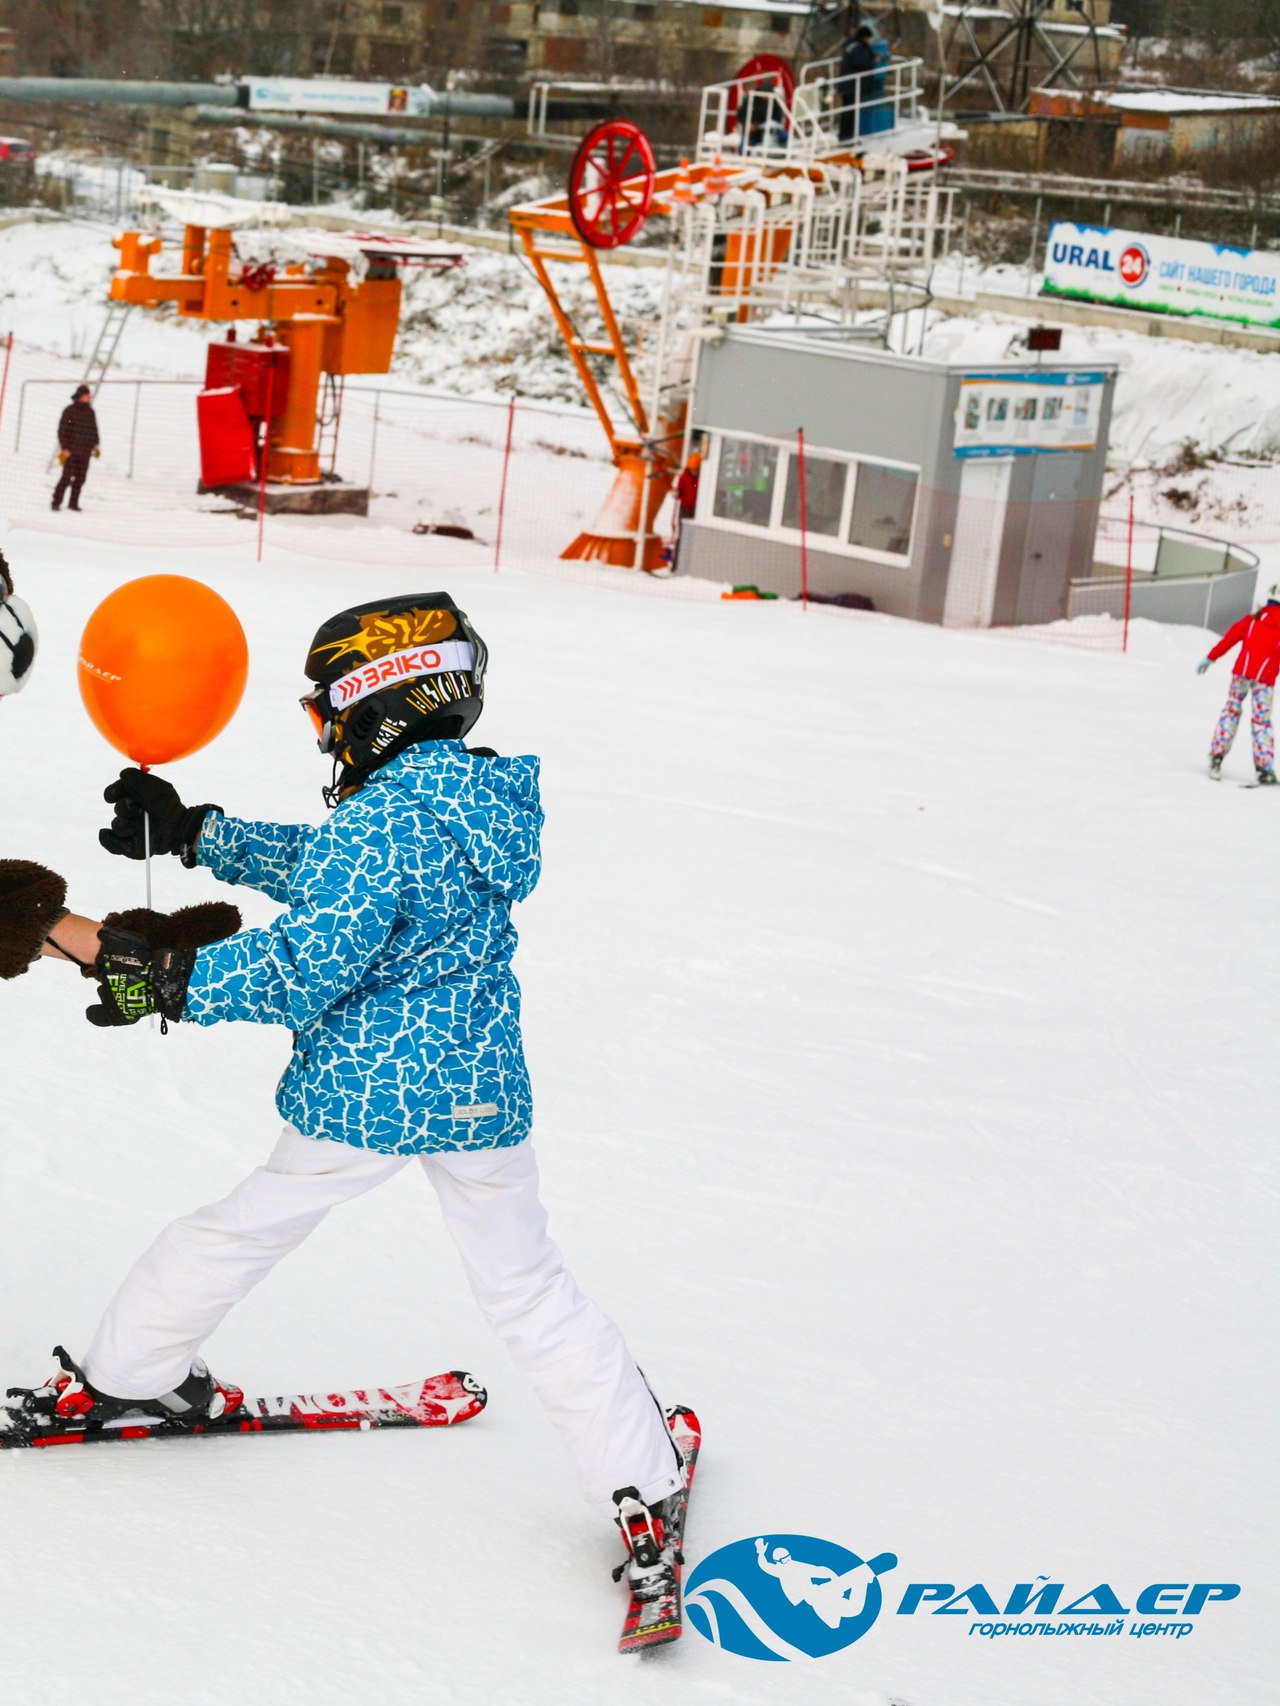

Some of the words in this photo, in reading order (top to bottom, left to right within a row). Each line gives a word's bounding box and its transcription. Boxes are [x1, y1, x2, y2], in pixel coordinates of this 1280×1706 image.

[1053, 243, 1115, 271] URAL
[1121, 254, 1143, 276] 24
[1188, 266, 1232, 289] НАШЕГО
[1233, 272, 1276, 295] ГОРОДА
[363, 650, 441, 688] BRIKO
